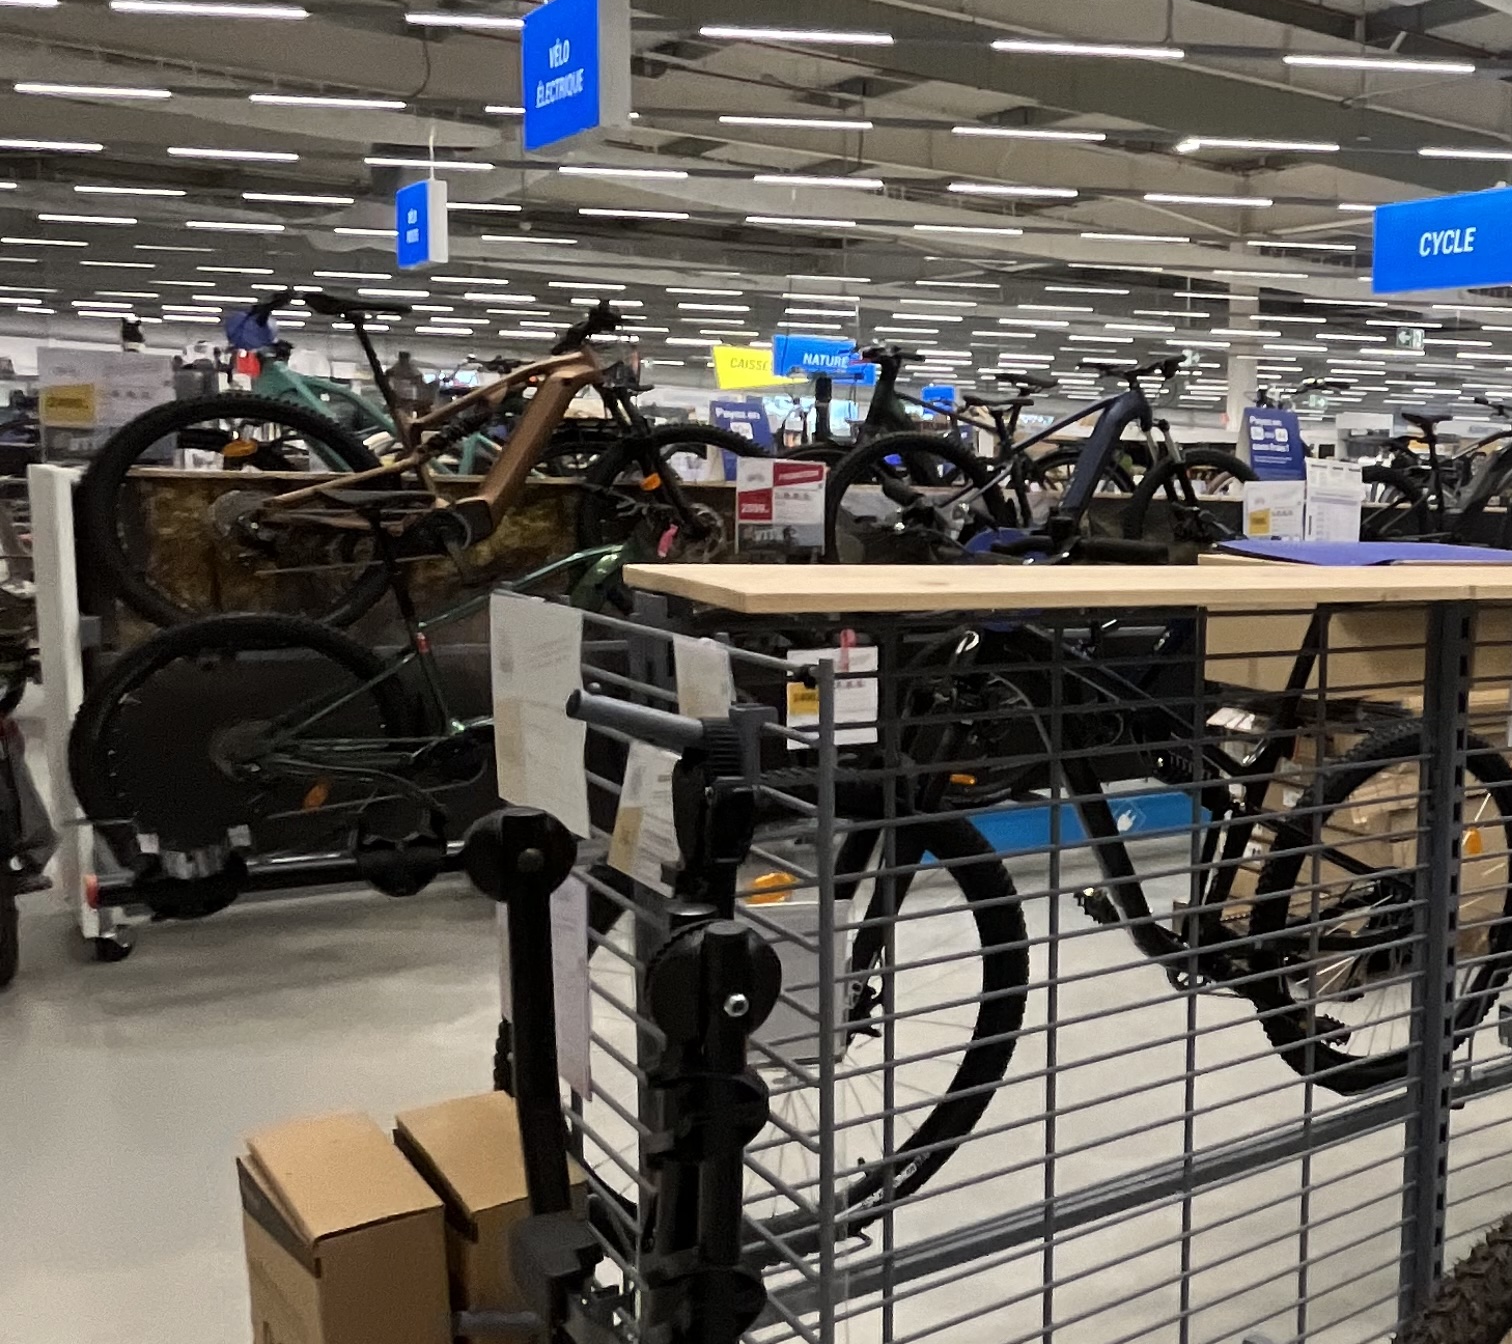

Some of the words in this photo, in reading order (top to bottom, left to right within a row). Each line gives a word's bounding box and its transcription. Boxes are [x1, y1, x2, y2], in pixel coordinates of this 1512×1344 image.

[549, 38, 571, 69] VÉLO
[1419, 226, 1477, 257] CYCLE
[803, 352, 849, 369] NATURE
